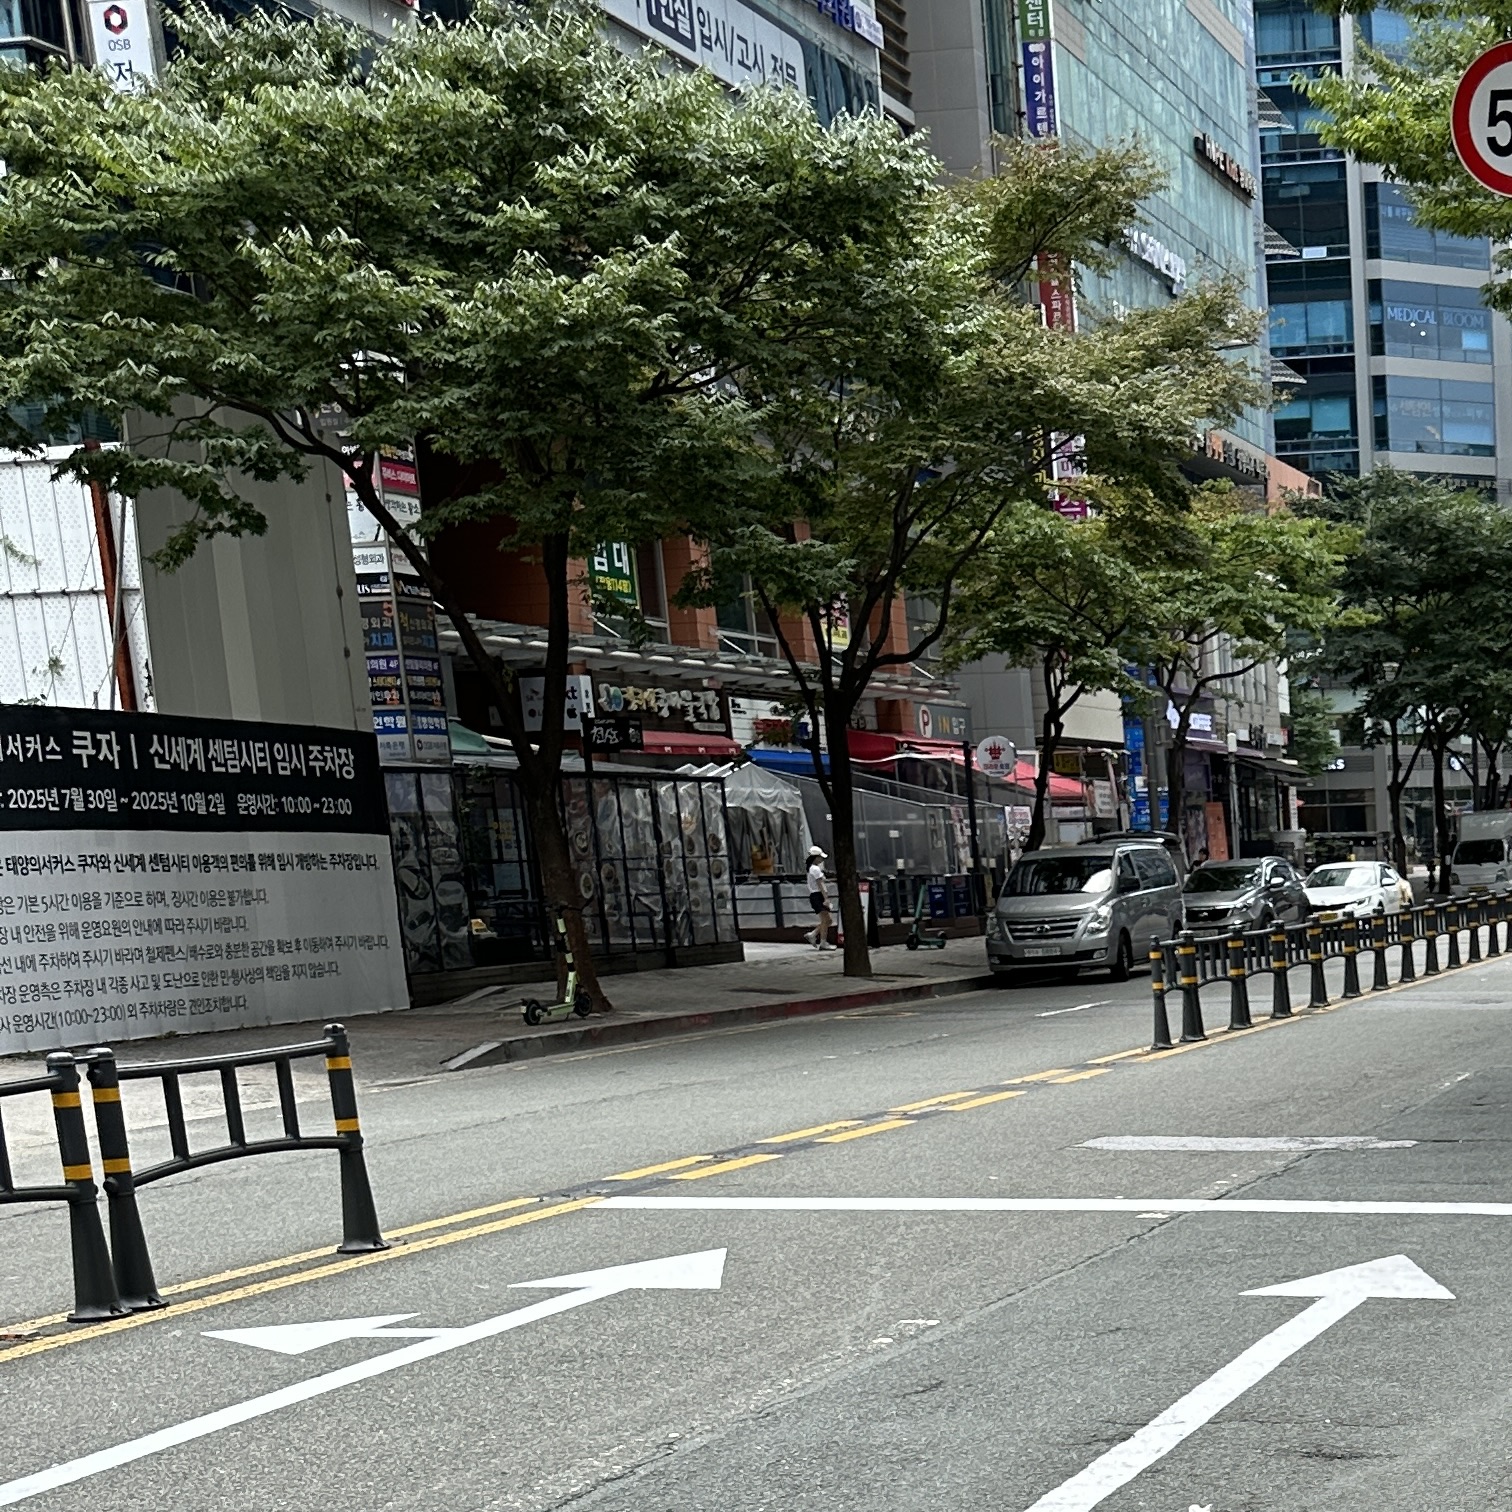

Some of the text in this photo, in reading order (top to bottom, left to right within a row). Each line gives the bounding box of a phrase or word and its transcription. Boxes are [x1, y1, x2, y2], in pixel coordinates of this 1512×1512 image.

[108, 39, 131, 51] OSB
[696, 7, 765, 83] 입시/고시
[1387, 307, 1484, 328] MEDICAL BLOOM
[938, 715, 950, 734] IN
[0, 733, 62, 762] 서커스
[72, 731, 121, 769] 쿠자
[149, 734, 206, 772] 신세계
[208, 738, 272, 775] 센텀시티
[274, 742, 307, 777] 임시
[308, 745, 355, 779] 주차장
[8, 787, 60, 811] 2025년
[61, 788, 85, 811] 7월
[87, 788, 118, 812] 30일
[131, 791, 178, 813] 2025년
[181, 793, 207, 814] 10월
[208, 793, 226, 815] 2일
[237, 793, 280, 815] 운영시간:
[281, 796, 312, 814] 10:00
[322, 797, 353, 815] 23:00
[5, 854, 76, 876] 태양의서커스
[77, 853, 111, 873] 쿠자와
[113, 854, 146, 873] 신세계
[149, 853, 190, 873] 센텀시티
[192, 853, 228, 873] 이용객의
[230, 853, 256, 873] 편의를
[258, 853, 275, 872] 위해
[277, 853, 294, 871] 임시
[295, 853, 329, 872] 개방하는
[17, 894, 40, 914] 기본
[42, 893, 70, 913] 5시간
[72, 891, 102, 912] 이용을
[104, 891, 144, 912] 기준으로
[172, 890, 198, 908] 장시간
[200, 889, 226, 908] 이용은
[11, 925, 22, 944] 내
[23, 924, 56, 943] 안전을
[58, 922, 80, 941] 위해
[81, 920, 131, 939] 운영요원의
[132, 918, 162, 936] 안내에
[165, 918, 185, 935] 따라
[187, 917, 212, 935] 주시기
[15, 954, 37, 973] 내에
[39, 951, 81, 971] 주차하여
[83, 949, 113, 968] 주시기
[115, 946, 144, 966] 바라며
[225, 941, 249, 960] 충분한
[251, 939, 275, 958] 공간을
[276, 938, 293, 956] 확보
[295, 937, 302, 953] 후
[303, 936, 334, 954] 이동하여
[335, 935, 357, 951] 주시기
[19, 982, 61, 1003] 운영측은
[63, 979, 94, 998] 주차장
[96, 977, 107, 995] 내
[108, 976, 128, 994] 각종
[130, 975, 149, 992] 사고
[151, 974, 161, 991] 및
[163, 972, 200, 989] 도난으로
[201, 971, 219, 987] 인한
[266, 965, 290, 982] 책임을
[292, 964, 308, 979] 지지
[128, 1003, 138, 1020] 외
[139, 998, 187, 1018] 주차차량은
